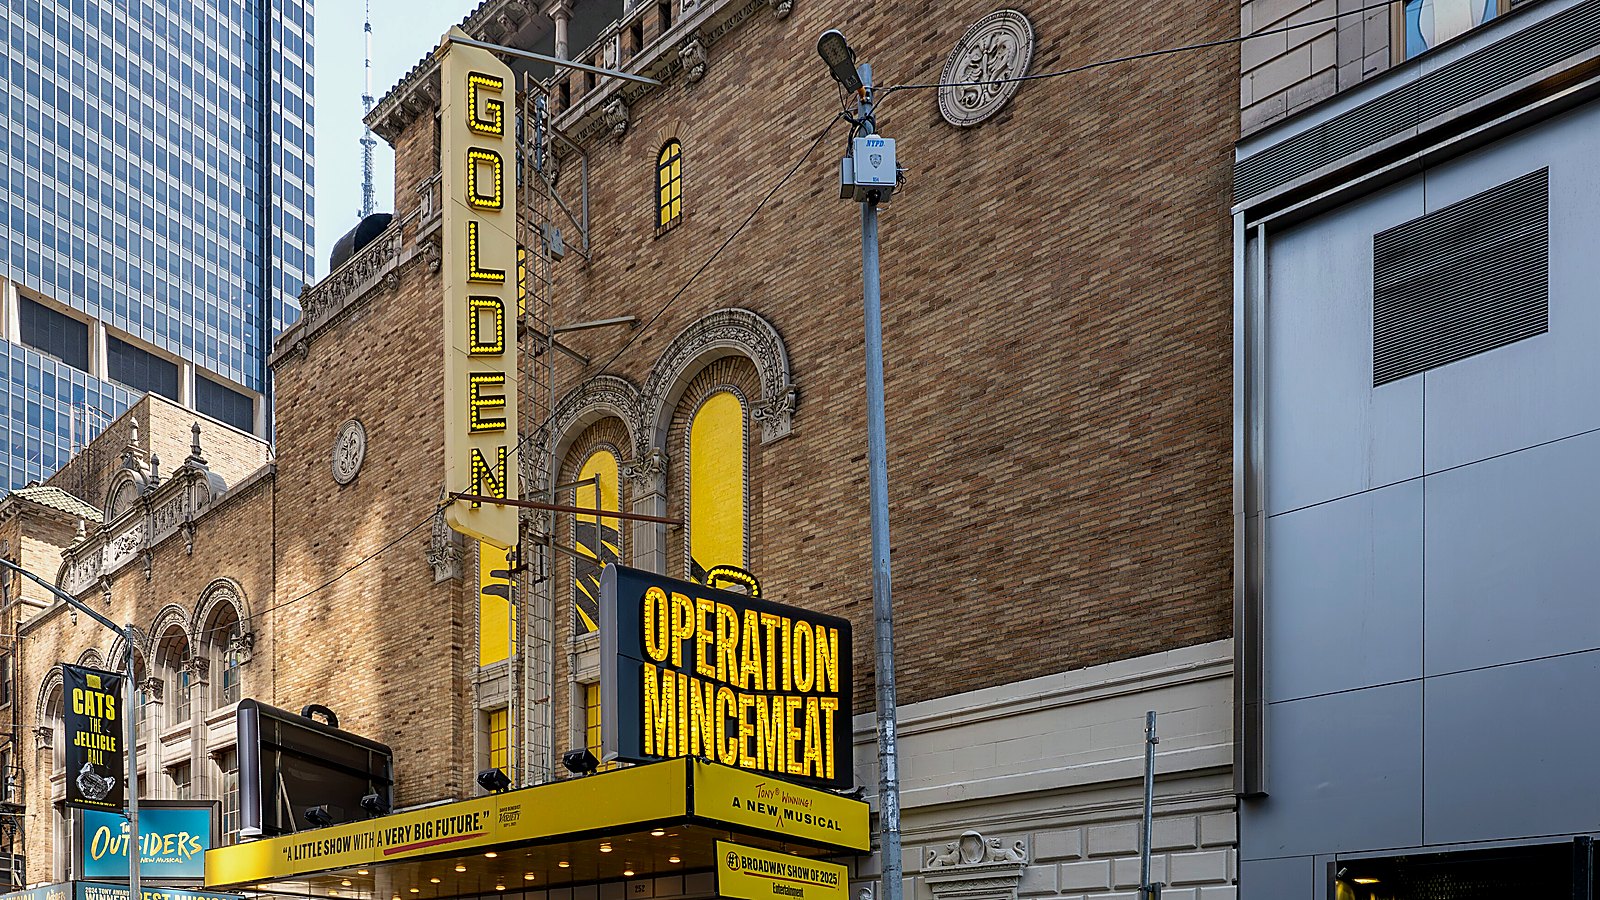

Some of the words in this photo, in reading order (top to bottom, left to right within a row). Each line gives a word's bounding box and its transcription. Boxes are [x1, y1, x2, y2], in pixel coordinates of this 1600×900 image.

[467, 71, 507, 508] GOLDEN
[644, 586, 838, 693] OPERATION
[73, 688, 115, 720] CATS
[89, 717, 101, 733] THE
[644, 662, 838, 779] MINCEMEAT
[74, 731, 116, 752] JELLICLE
[88, 749, 103, 765] BALL
[732, 797, 741, 808] A
[747, 800, 778, 816] NEW
[784, 809, 841, 831] MUSICAL
[782, 791, 813, 811] WINNING!
[294, 841, 322, 860] LITTLE
[324, 836, 352, 856] SHOW
[354, 832, 375, 851] WITH
[377, 830, 383, 848] A
[385, 825, 412, 845] VERY
[414, 821, 433, 840] BIG
[728, 854, 739, 868] #1
[741, 856, 786, 876] BROADWAY
[788, 864, 810, 880] SHOW
[811, 868, 820, 881] OF
[772, 882, 804, 898] Entertainment
